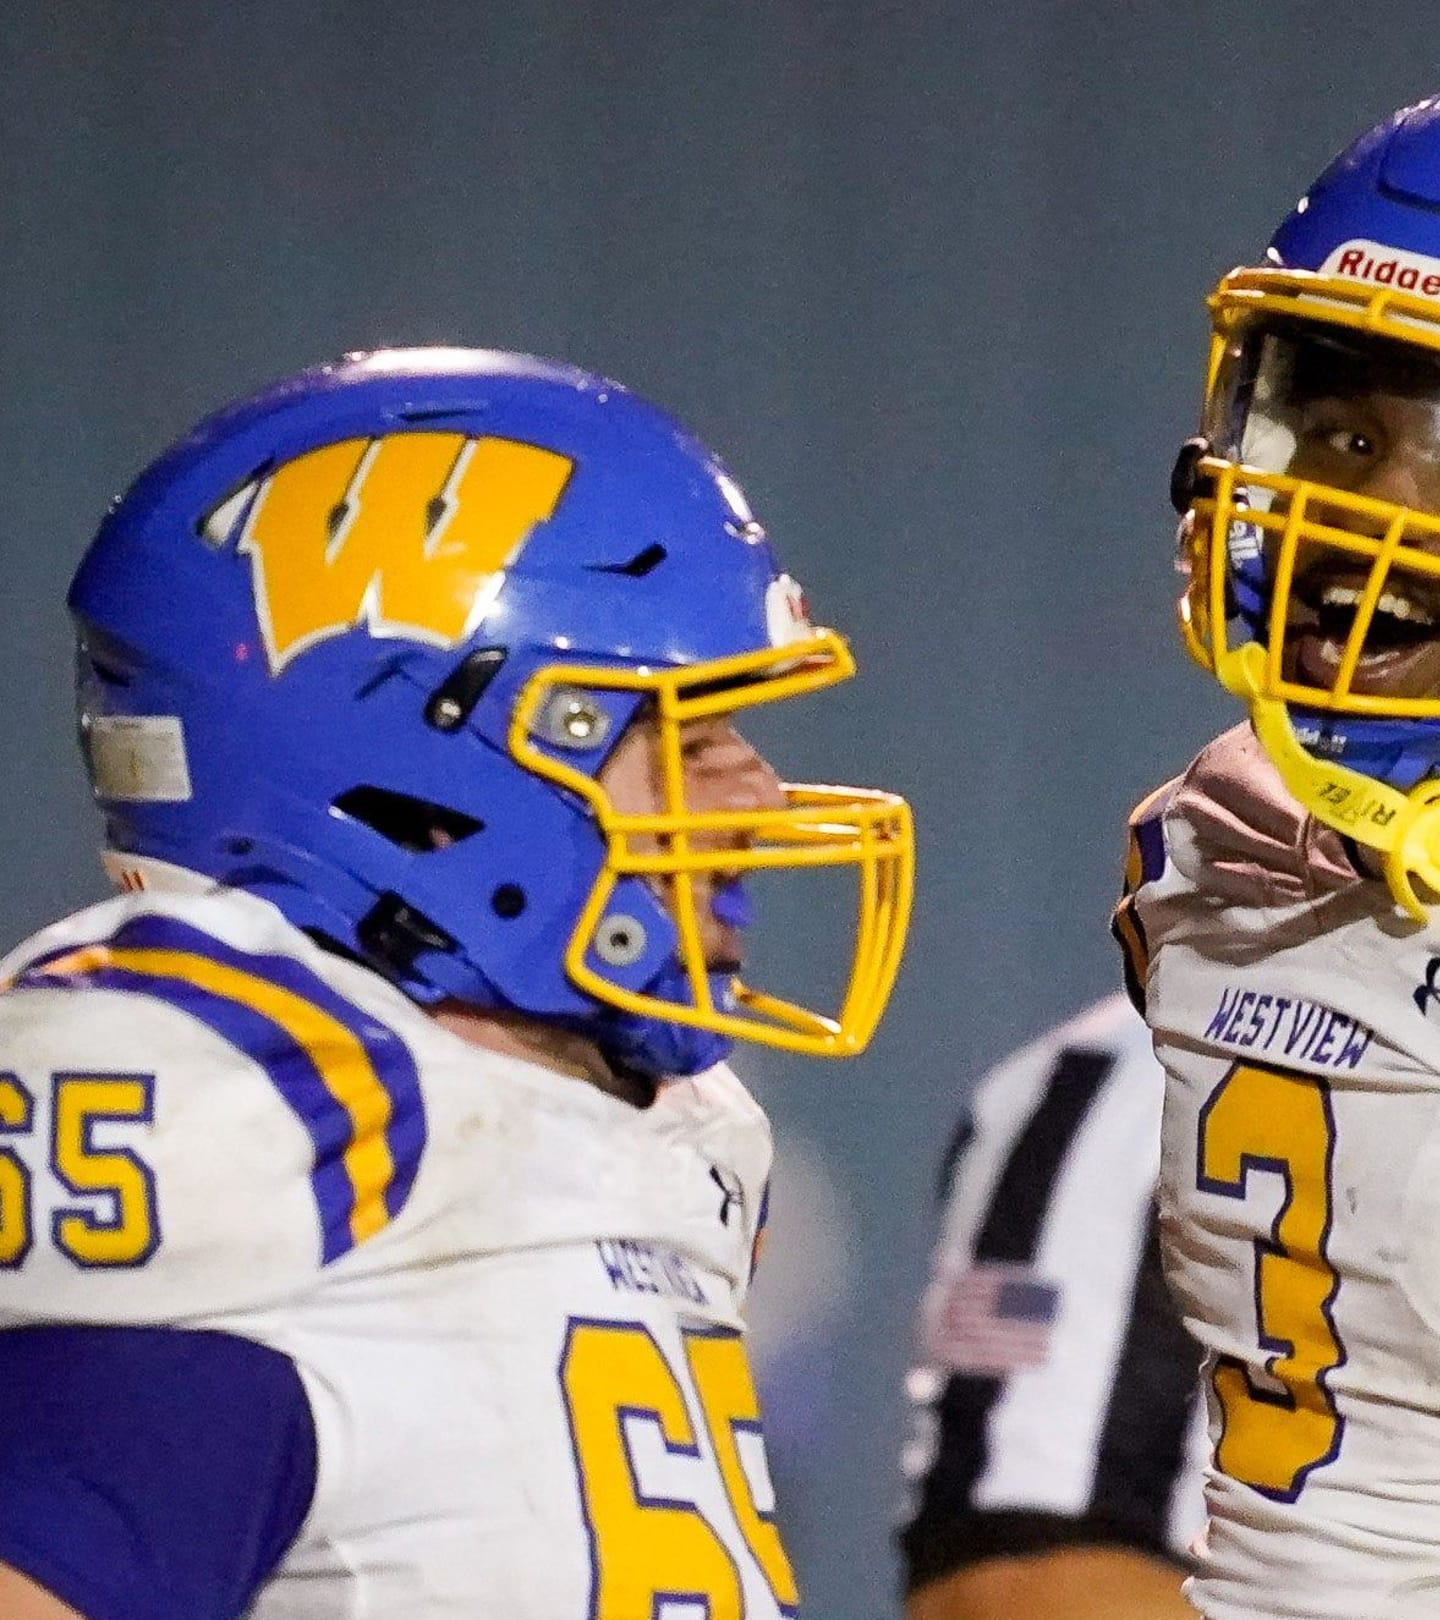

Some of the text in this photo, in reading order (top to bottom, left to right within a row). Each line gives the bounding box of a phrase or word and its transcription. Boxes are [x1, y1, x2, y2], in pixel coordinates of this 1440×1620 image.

[198, 431, 578, 678] W
[1203, 986, 1374, 1069] WESTVIEW
[1196, 1057, 1348, 1504] 3
